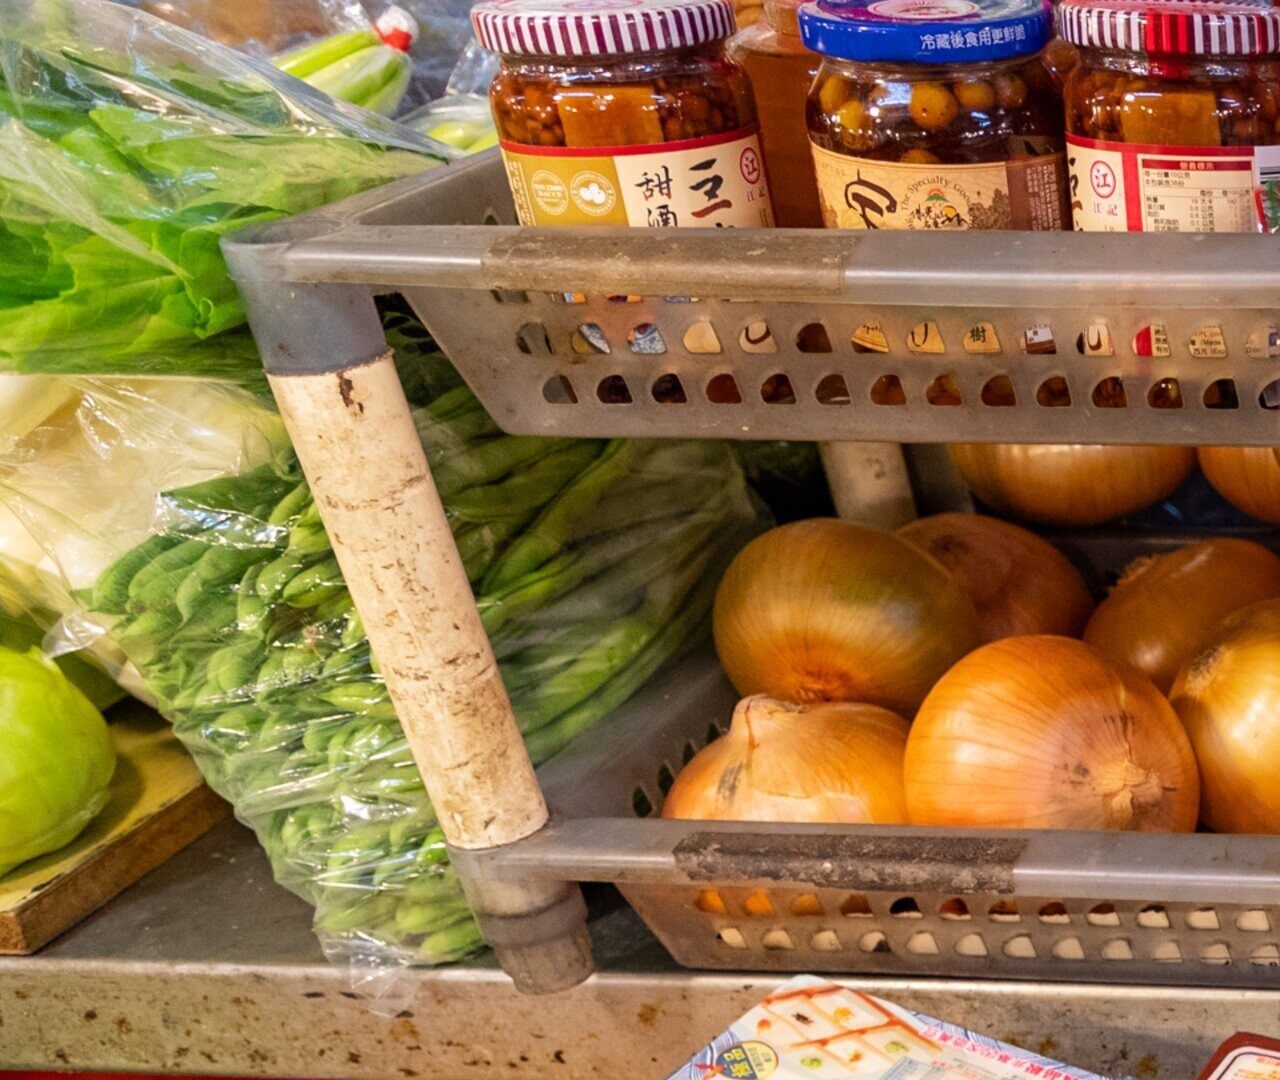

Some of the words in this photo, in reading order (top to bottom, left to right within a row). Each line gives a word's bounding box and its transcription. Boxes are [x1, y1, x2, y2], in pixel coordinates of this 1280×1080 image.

[907, 174, 951, 194] Specialty
[1094, 168, 1111, 190] 江
[688, 157, 735, 227] 豆
